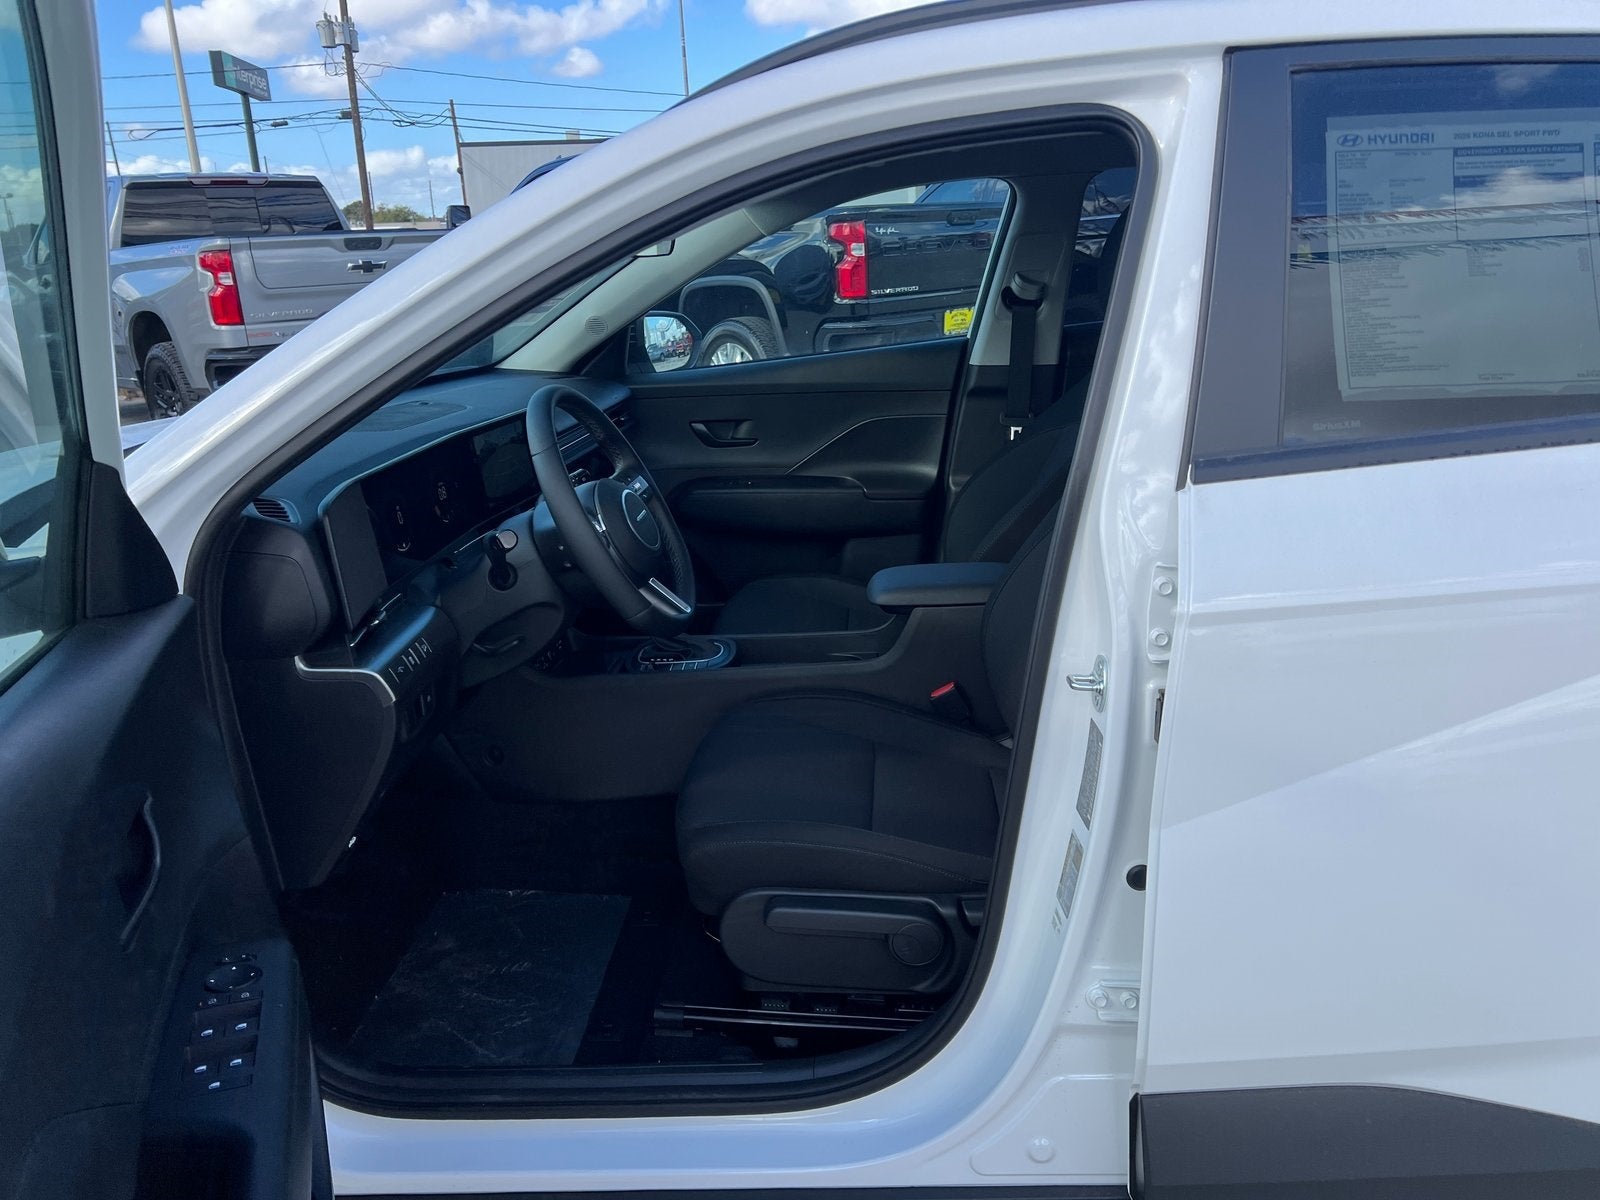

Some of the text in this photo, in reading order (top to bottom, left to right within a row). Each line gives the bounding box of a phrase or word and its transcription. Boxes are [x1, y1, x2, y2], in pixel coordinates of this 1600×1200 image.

[1367, 132, 1434, 145] HYUNDAI
[1472, 131, 1496, 139] KONA
[1497, 130, 1511, 138] SEL
[1513, 129, 1541, 137] SPORT
[871, 285, 919, 295] SILVERADO
